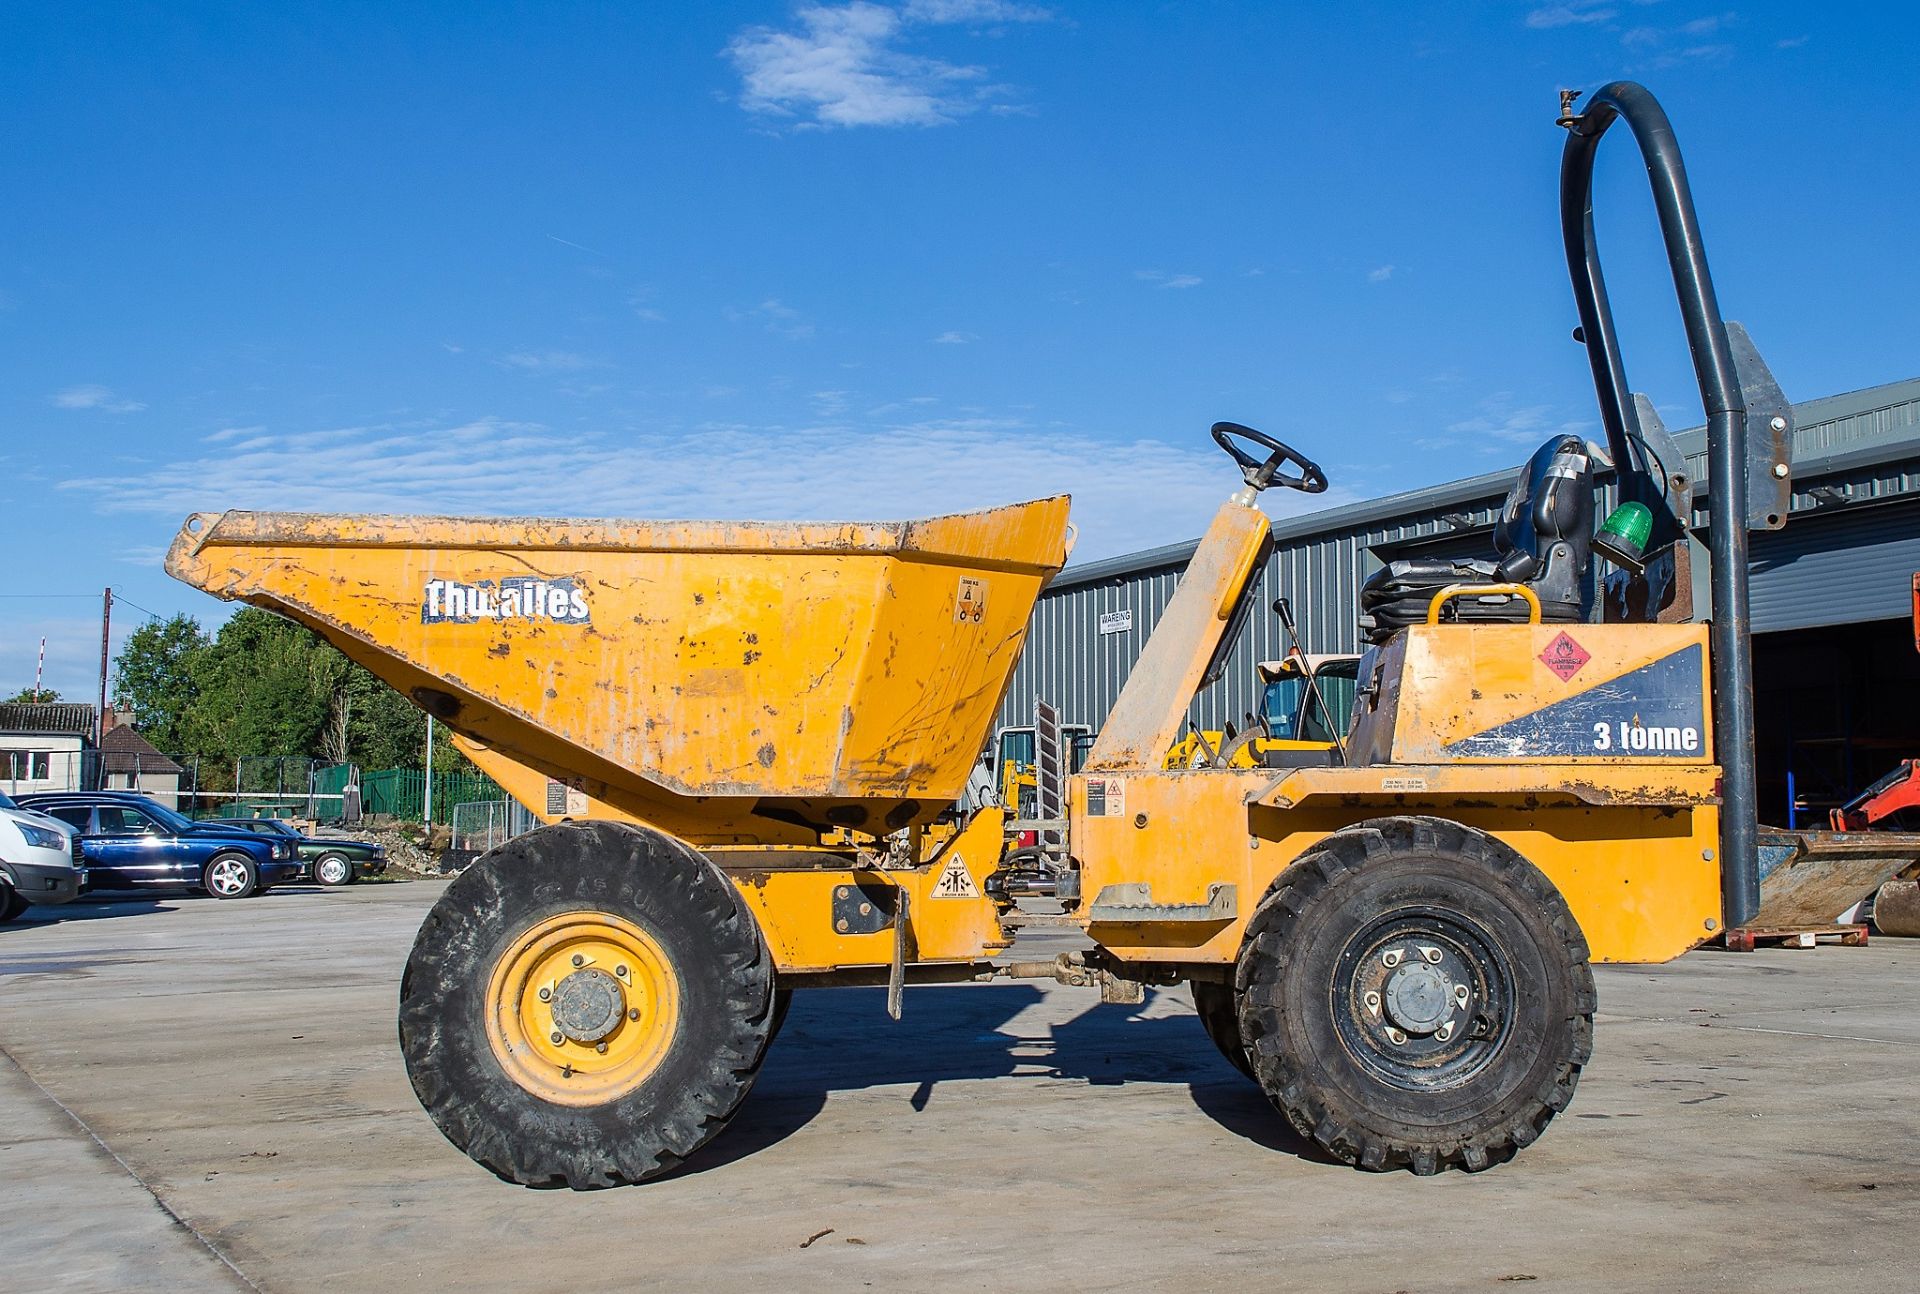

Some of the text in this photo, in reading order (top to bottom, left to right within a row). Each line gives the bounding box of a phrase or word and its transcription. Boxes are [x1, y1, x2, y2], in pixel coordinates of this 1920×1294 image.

[425, 580, 589, 619] Thwaites
[1102, 611, 1131, 624] WAREING
[1593, 721, 1698, 751] 3 tonne
